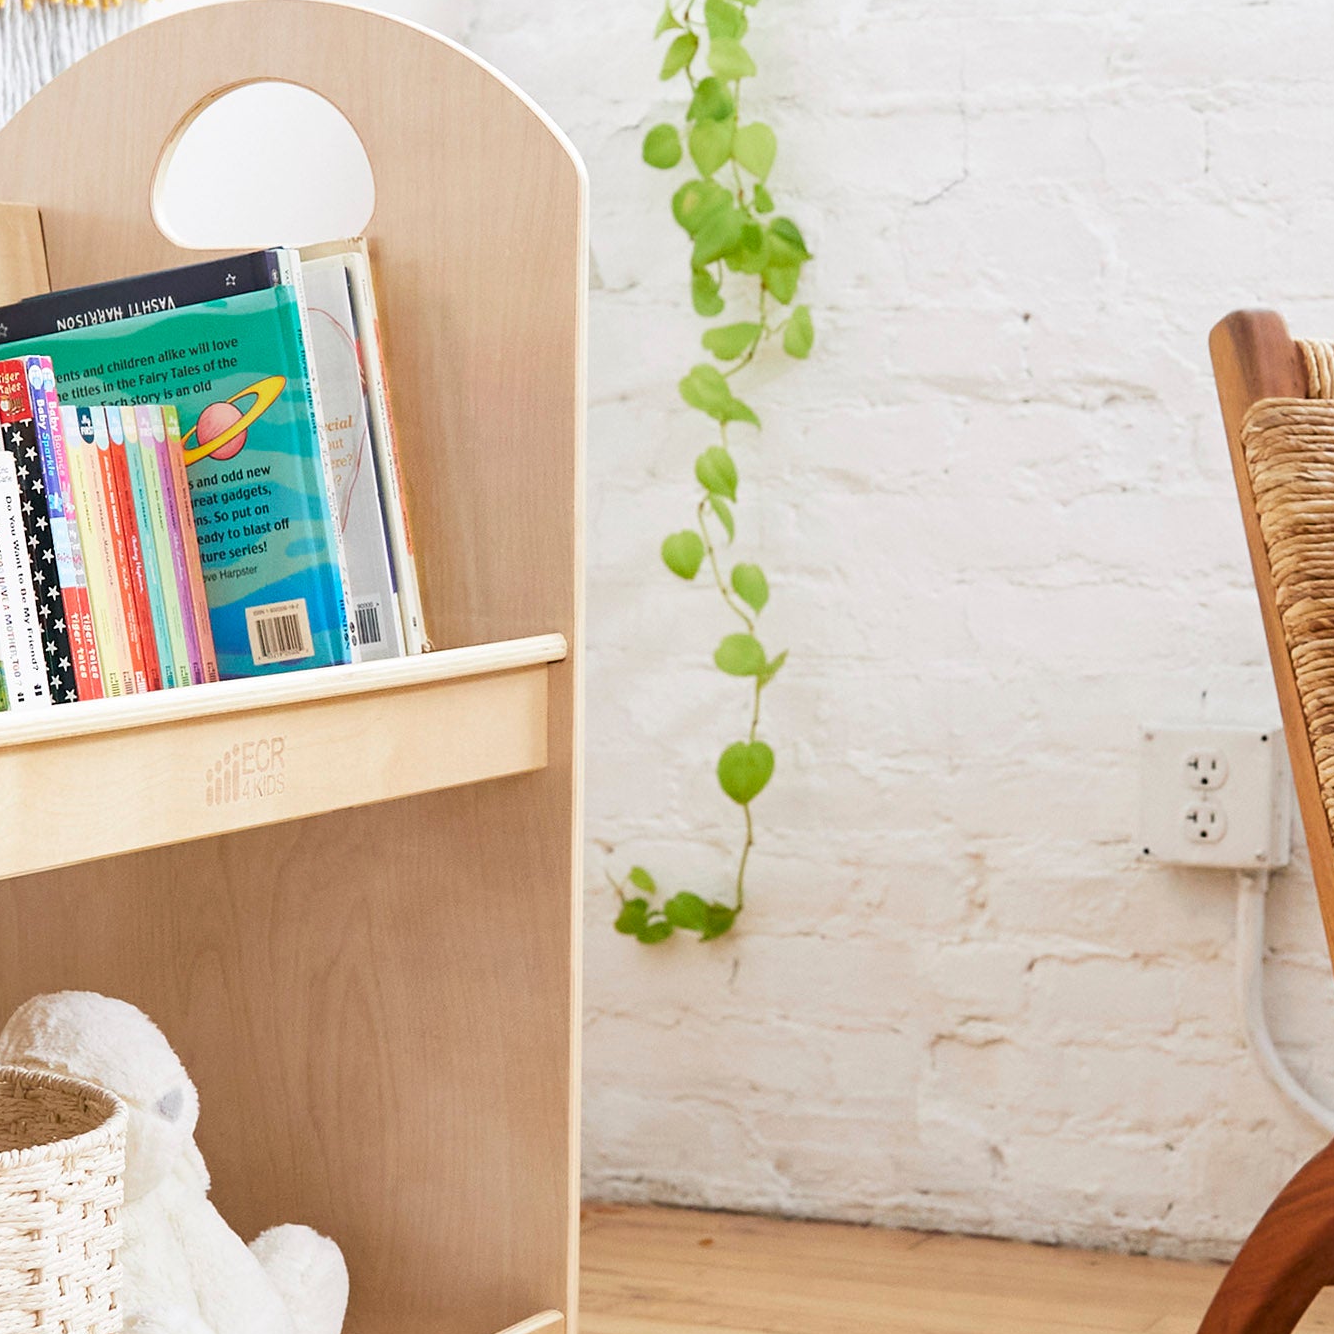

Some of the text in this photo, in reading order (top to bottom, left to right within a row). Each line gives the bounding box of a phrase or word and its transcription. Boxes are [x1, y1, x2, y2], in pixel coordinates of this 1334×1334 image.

[56, 296, 176, 331] VASHTI HARRISON
[55, 337, 239, 384] ents and children alike will love
[72, 383, 101, 399] titles
[103, 380, 114, 393] in
[117, 375, 136, 389] the
[139, 369, 168, 389] Fairy
[171, 363, 200, 378] Tales
[203, 359, 216, 373] of
[217, 356, 237, 370] the
[0, 382, 21, 395] tales
[130, 389, 160, 406] story
[163, 387, 173, 399] is
[175, 386, 189, 397] an
[193, 380, 212, 393] old
[36, 399, 55, 476] Baby Sparkle
[49, 401, 65, 476] Baby Bounce
[196, 473, 218, 488] and
[221, 469, 244, 484] odd
[246, 465, 271, 478] new
[191, 485, 272, 509] reat gadgets,
[193, 504, 270, 527] ns. So put on
[197, 518, 290, 546] eady to blast off
[200, 541, 268, 564] ture series!
[6, 496, 12, 511] Do
[13, 539, 22, 569] Want
[18, 573, 24, 584] to
[23, 607, 30, 624] My
[27, 628, 39, 671] Friend?
[219, 565, 258, 581] Harpster
[71, 612, 88, 679] tiger tales
[83, 613, 99, 679] tiger tales
[242, 736, 285, 775] ECR
